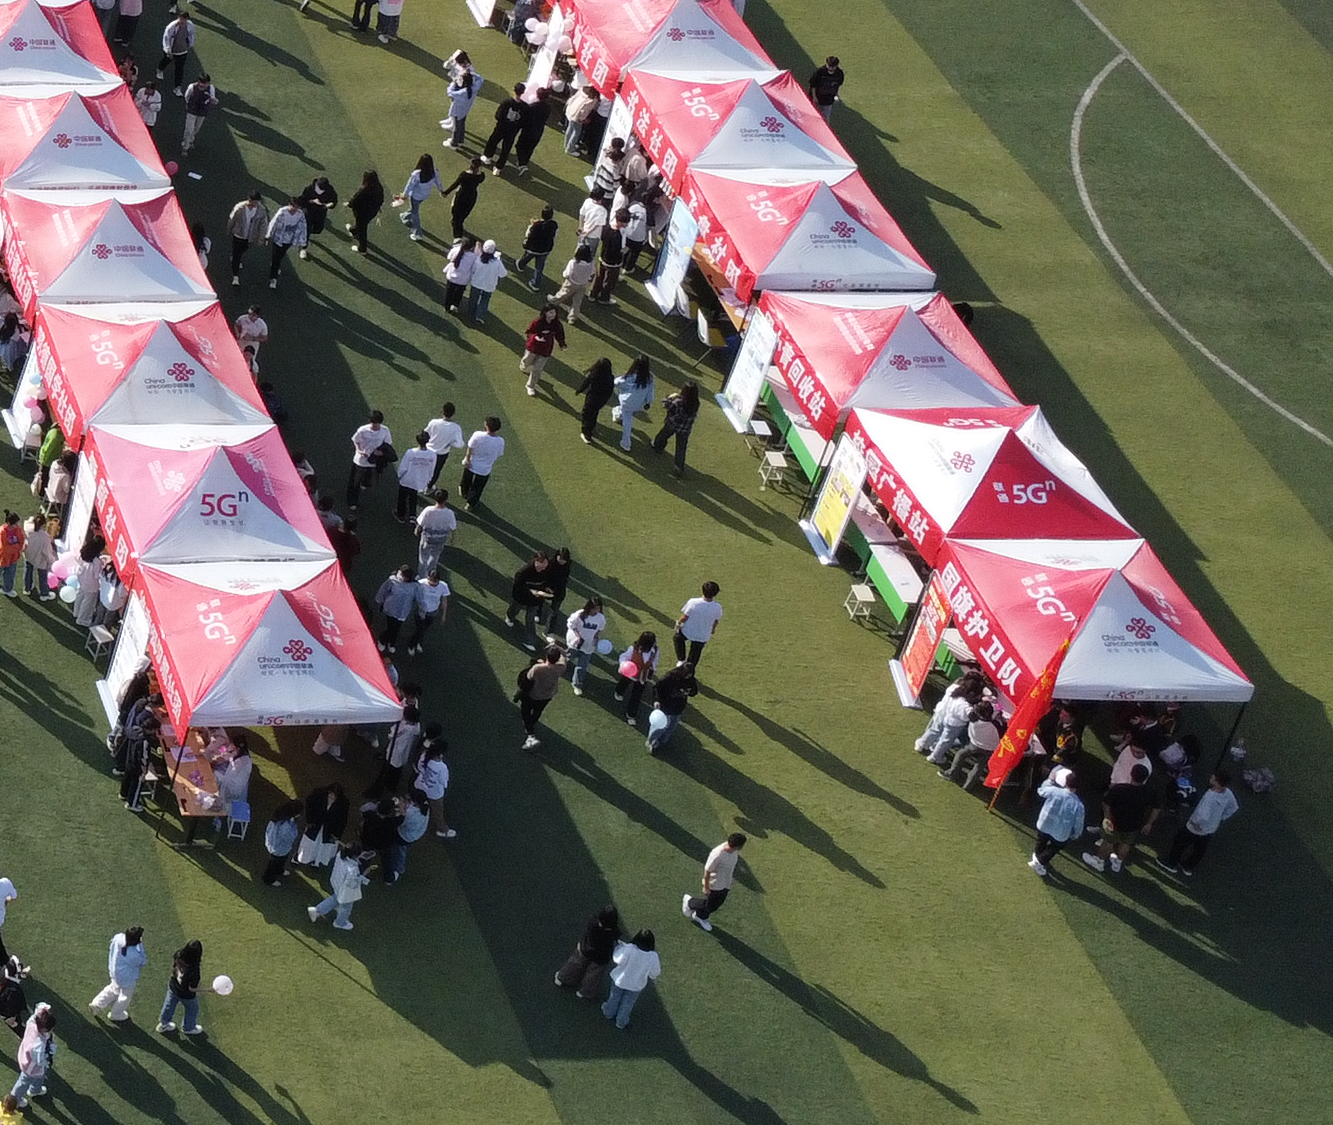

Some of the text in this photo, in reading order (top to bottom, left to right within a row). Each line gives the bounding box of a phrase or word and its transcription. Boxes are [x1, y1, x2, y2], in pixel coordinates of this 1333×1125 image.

[941, 562, 1022, 696] 国旗护卫队
